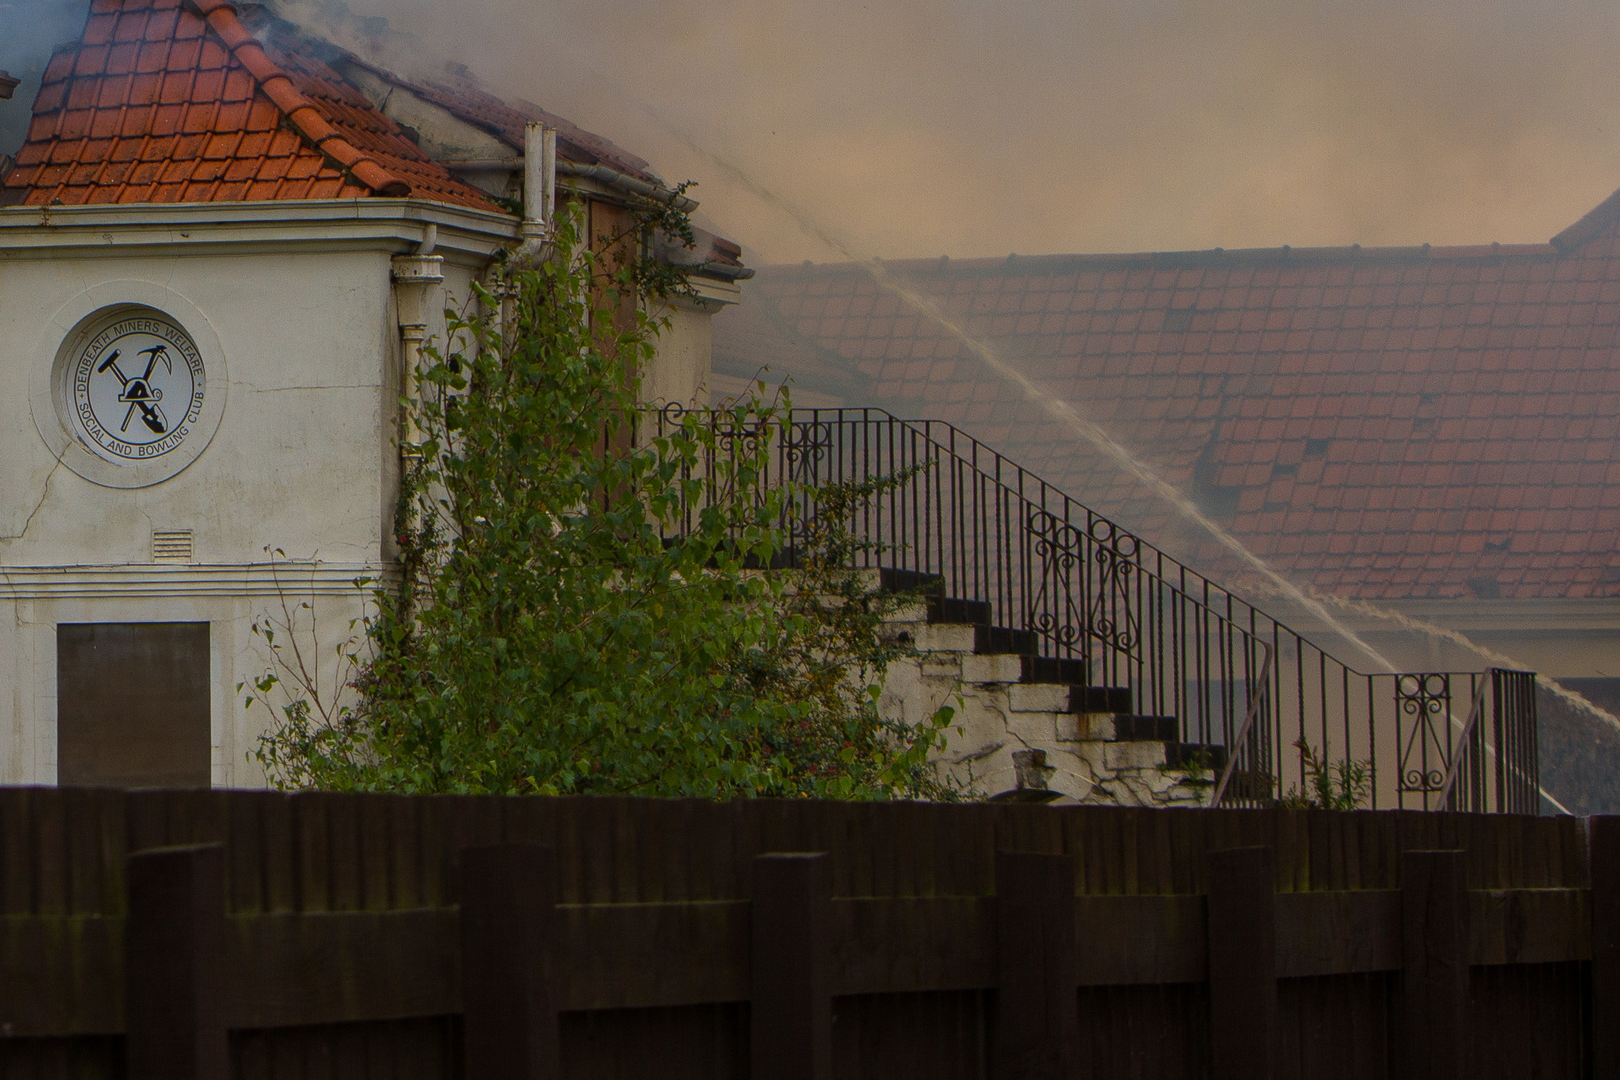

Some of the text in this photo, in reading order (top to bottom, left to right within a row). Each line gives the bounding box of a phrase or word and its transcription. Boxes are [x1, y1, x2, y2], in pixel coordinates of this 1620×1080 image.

[77, 320, 203, 392] DENBEATH MINERS WELFARE
[80, 392, 204, 457] SOCIAL AND BOWLING CLUB
